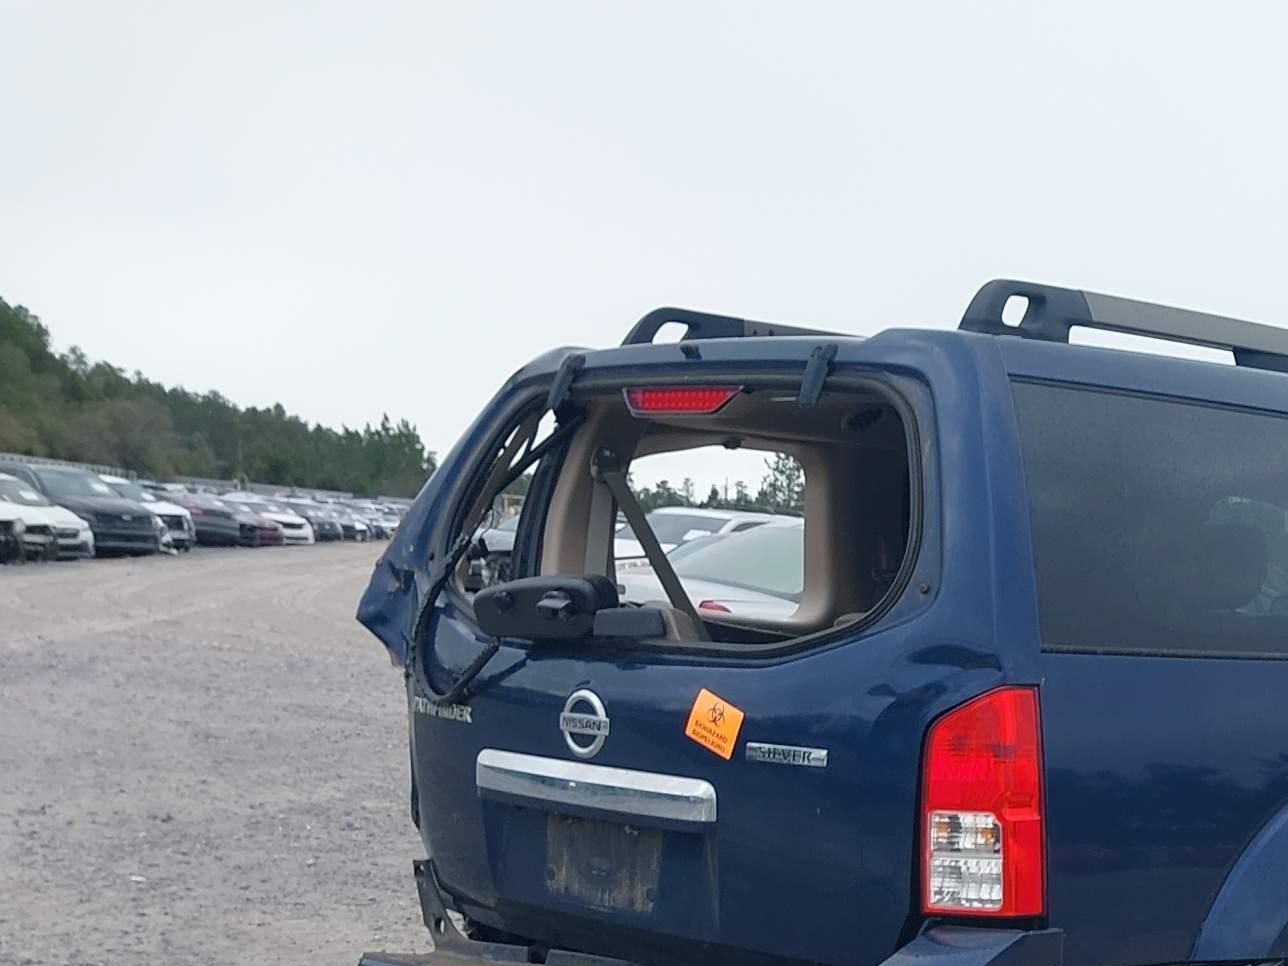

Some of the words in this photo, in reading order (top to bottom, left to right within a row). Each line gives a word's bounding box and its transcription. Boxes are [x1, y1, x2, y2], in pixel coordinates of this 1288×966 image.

[562, 716, 602, 732] NISSAN
[694, 720, 728, 744] BIOHAZARD
[758, 746, 812, 763] SILVER
